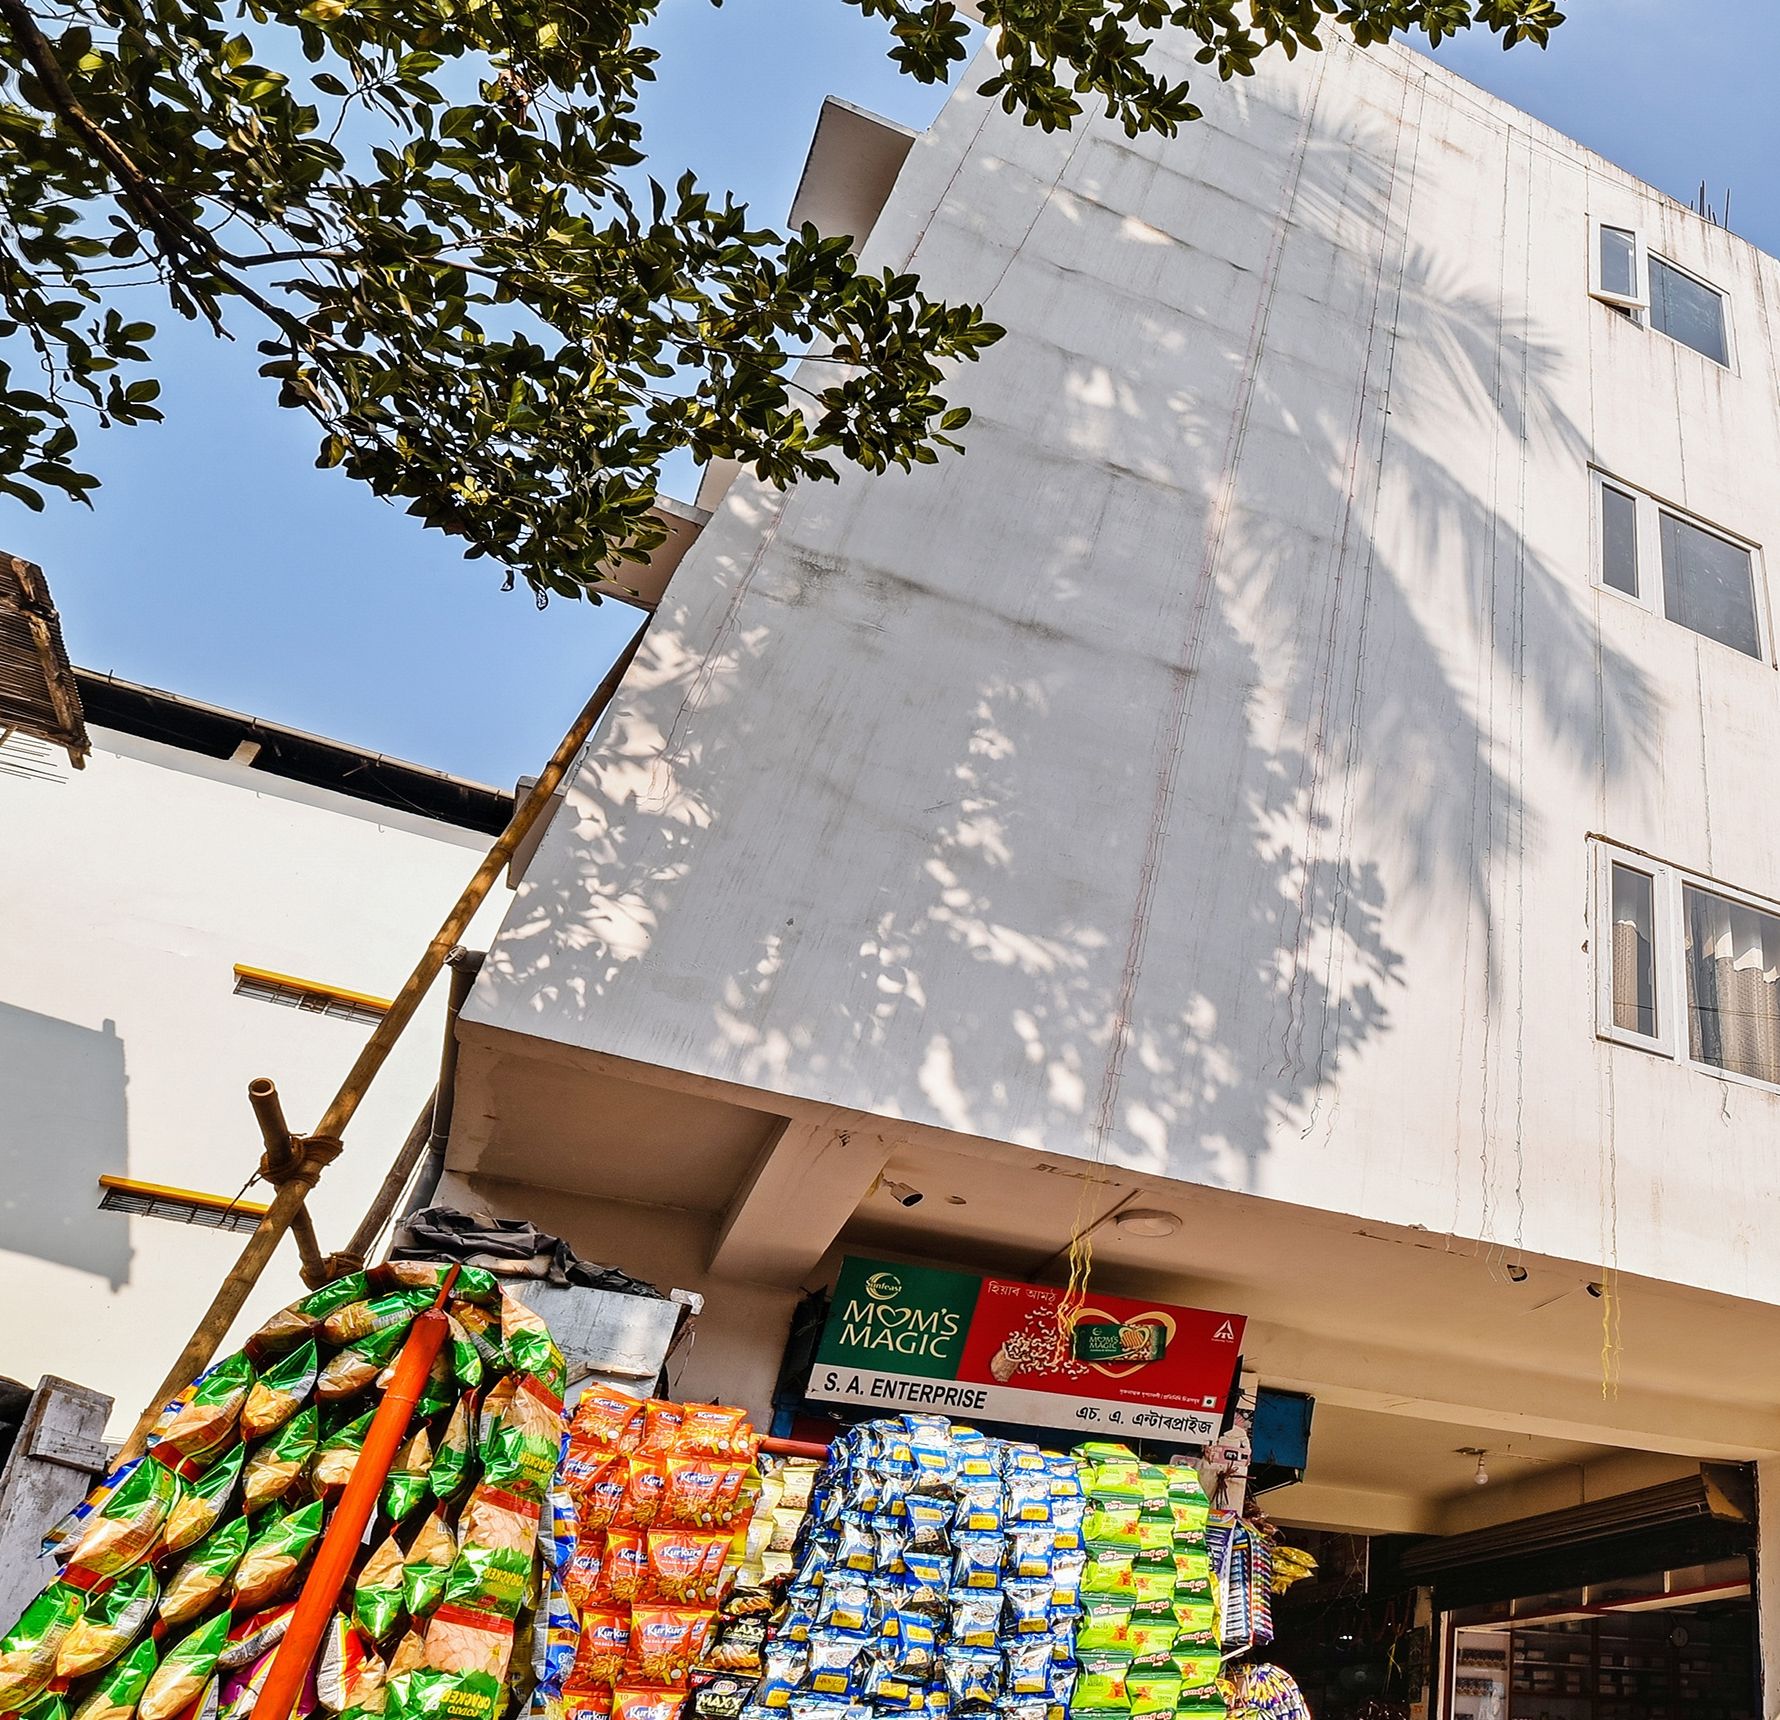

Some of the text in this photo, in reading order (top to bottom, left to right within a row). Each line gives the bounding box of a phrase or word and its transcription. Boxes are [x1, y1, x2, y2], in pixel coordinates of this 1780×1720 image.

[865, 1279, 903, 1293] Sunfeast
[838, 1323, 951, 1359] MAGIC
[824, 1372, 988, 1410] S. A. ENTERPRISE
[643, 1475, 665, 1487] Kurk
[620, 1548, 648, 1562] Kurku
[597, 1626, 630, 1640] Kurkur
[447, 1705, 480, 1717] POTATO
